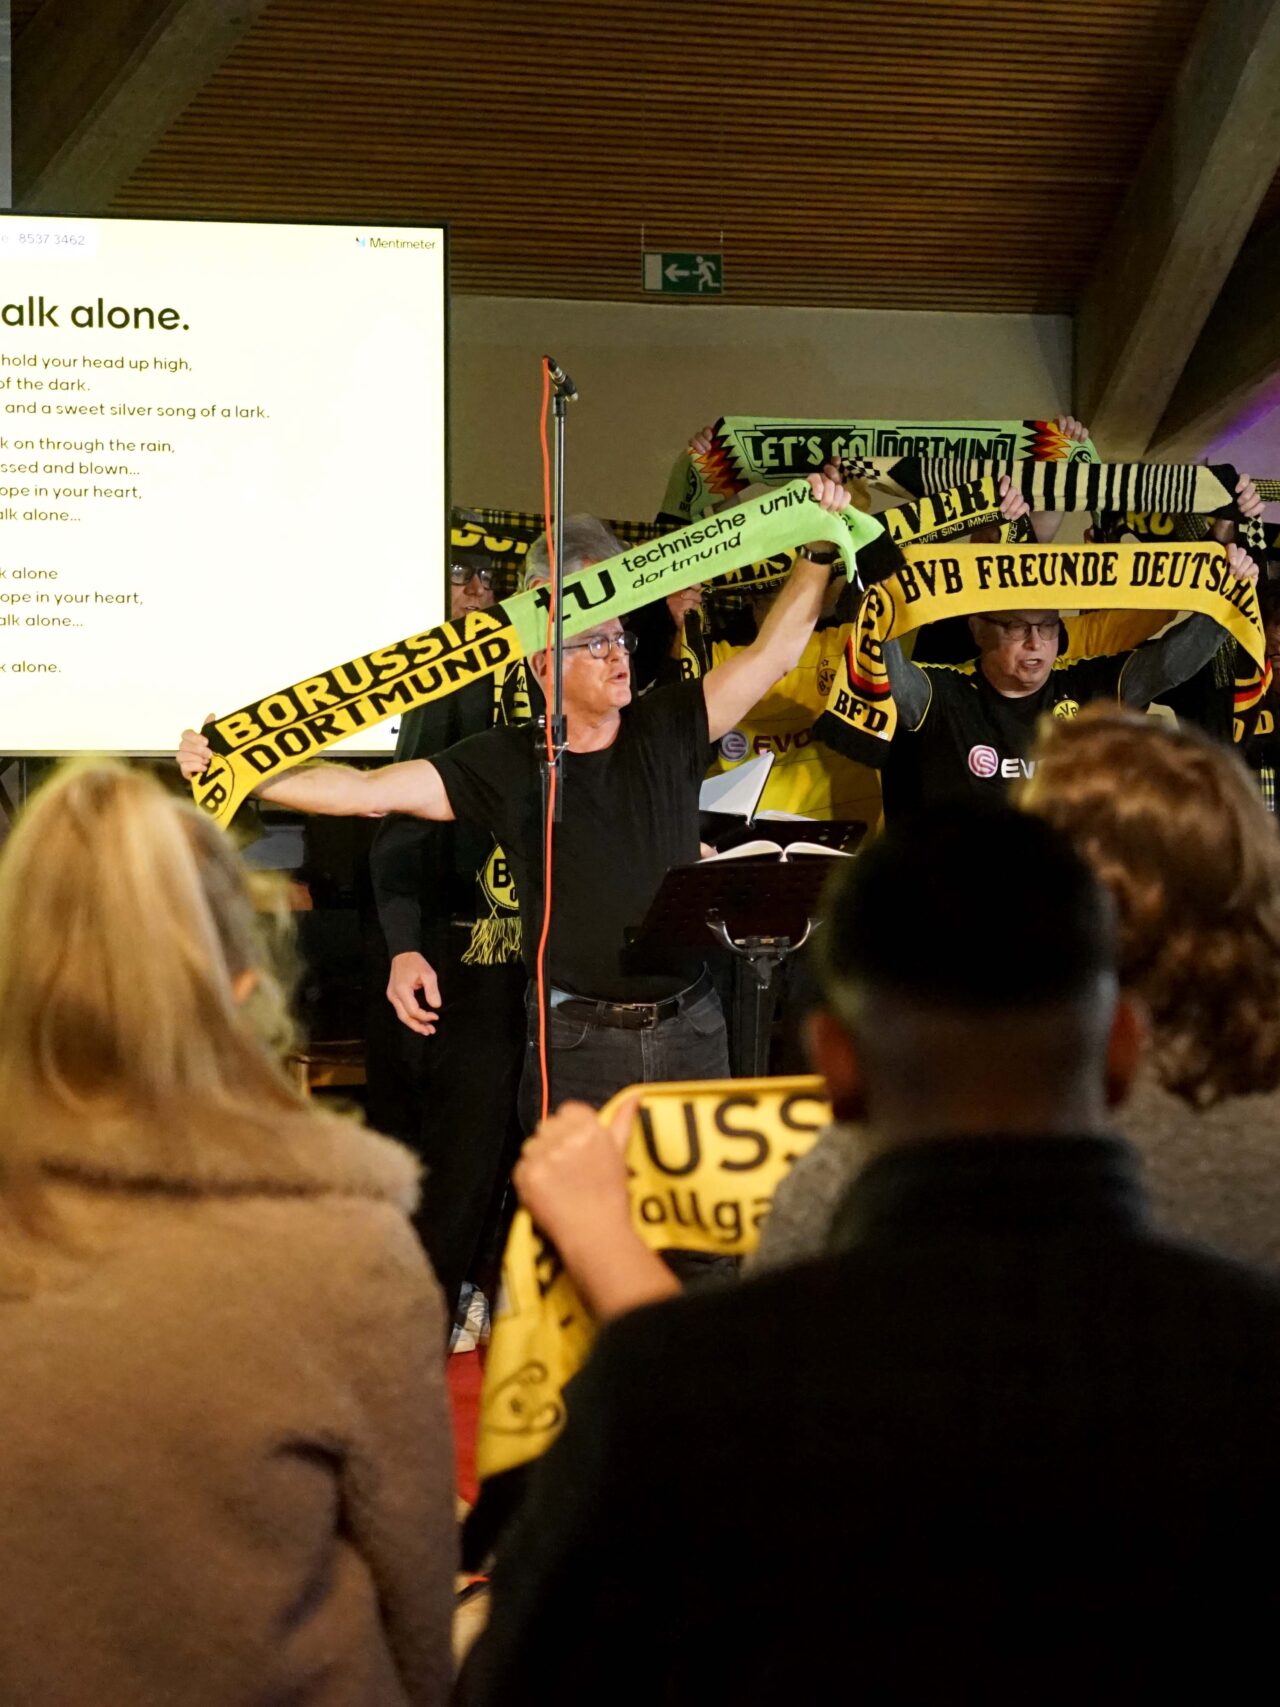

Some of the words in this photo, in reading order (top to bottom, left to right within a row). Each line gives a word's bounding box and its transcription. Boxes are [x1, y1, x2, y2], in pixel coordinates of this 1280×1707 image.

[18, 233, 50, 244] 8537
[54, 234, 86, 246] 3462
[369, 237, 437, 249] Mentimeter
[1, 296, 60, 328] alk
[71, 297, 190, 331] alone.
[1, 353, 38, 367] hold
[42, 357, 78, 370] your
[82, 355, 125, 369] head
[129, 359, 150, 373] up
[153, 356, 193, 373] high,
[17, 377, 44, 391] the
[48, 378, 91, 391] dark.
[5, 402, 37, 414] and
[42, 404, 52, 415] a
[56, 403, 105, 416] sweet
[110, 403, 152, 417] silver
[157, 407, 197, 420] song
[201, 405, 217, 418] of
[221, 408, 231, 419] a
[235, 405, 270, 419] lark.
[14, 440, 35, 450] on
[39, 437, 104, 454] through
[109, 438, 136, 452] the
[140, 440, 175, 454] rain,
[0, 461, 39, 474] ssed
[43, 461, 75, 474] and
[79, 461, 140, 475] blown...
[0, 486, 30, 499] ope
[34, 484, 49, 497] in
[53, 487, 88, 500] your
[93, 485, 142, 500] heart,
[23, 508, 81, 521] alone...
[919, 530, 938, 544] WIR
[941, 522, 965, 536] SIND
[968, 511, 999, 528] IMMER
[622, 513, 747, 573] technische
[632, 533, 742, 590] dortmund
[12, 567, 58, 580] alone
[902, 557, 963, 604] BVB
[976, 551, 1118, 589] FREUNDE
[0, 593, 31, 606] ope
[36, 591, 50, 603] in
[54, 594, 90, 606] your
[94, 591, 143, 605] heart,
[25, 614, 83, 627] alone...
[11, 660, 61, 673] alone.
[215, 610, 502, 749] BORUSSIA
[241, 636, 511, 775] DORTMUND
[834, 688, 889, 733] BFD
[198, 767, 228, 815] VB
